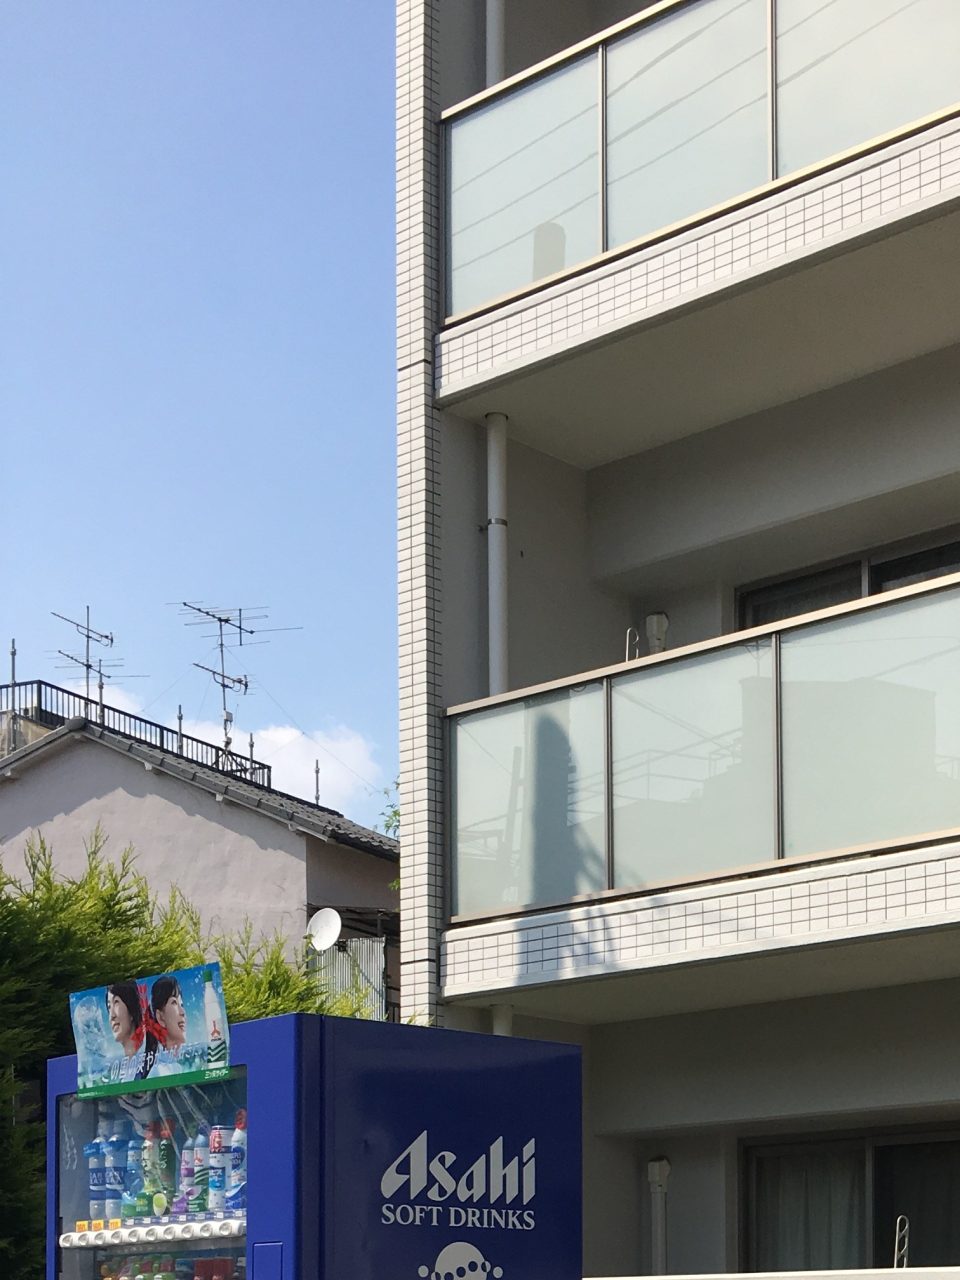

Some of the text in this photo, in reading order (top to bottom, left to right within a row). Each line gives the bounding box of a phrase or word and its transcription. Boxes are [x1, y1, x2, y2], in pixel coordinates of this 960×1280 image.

[380, 1129, 537, 1206] Asahi
[381, 1203, 536, 1231] SOFT DRINKS
